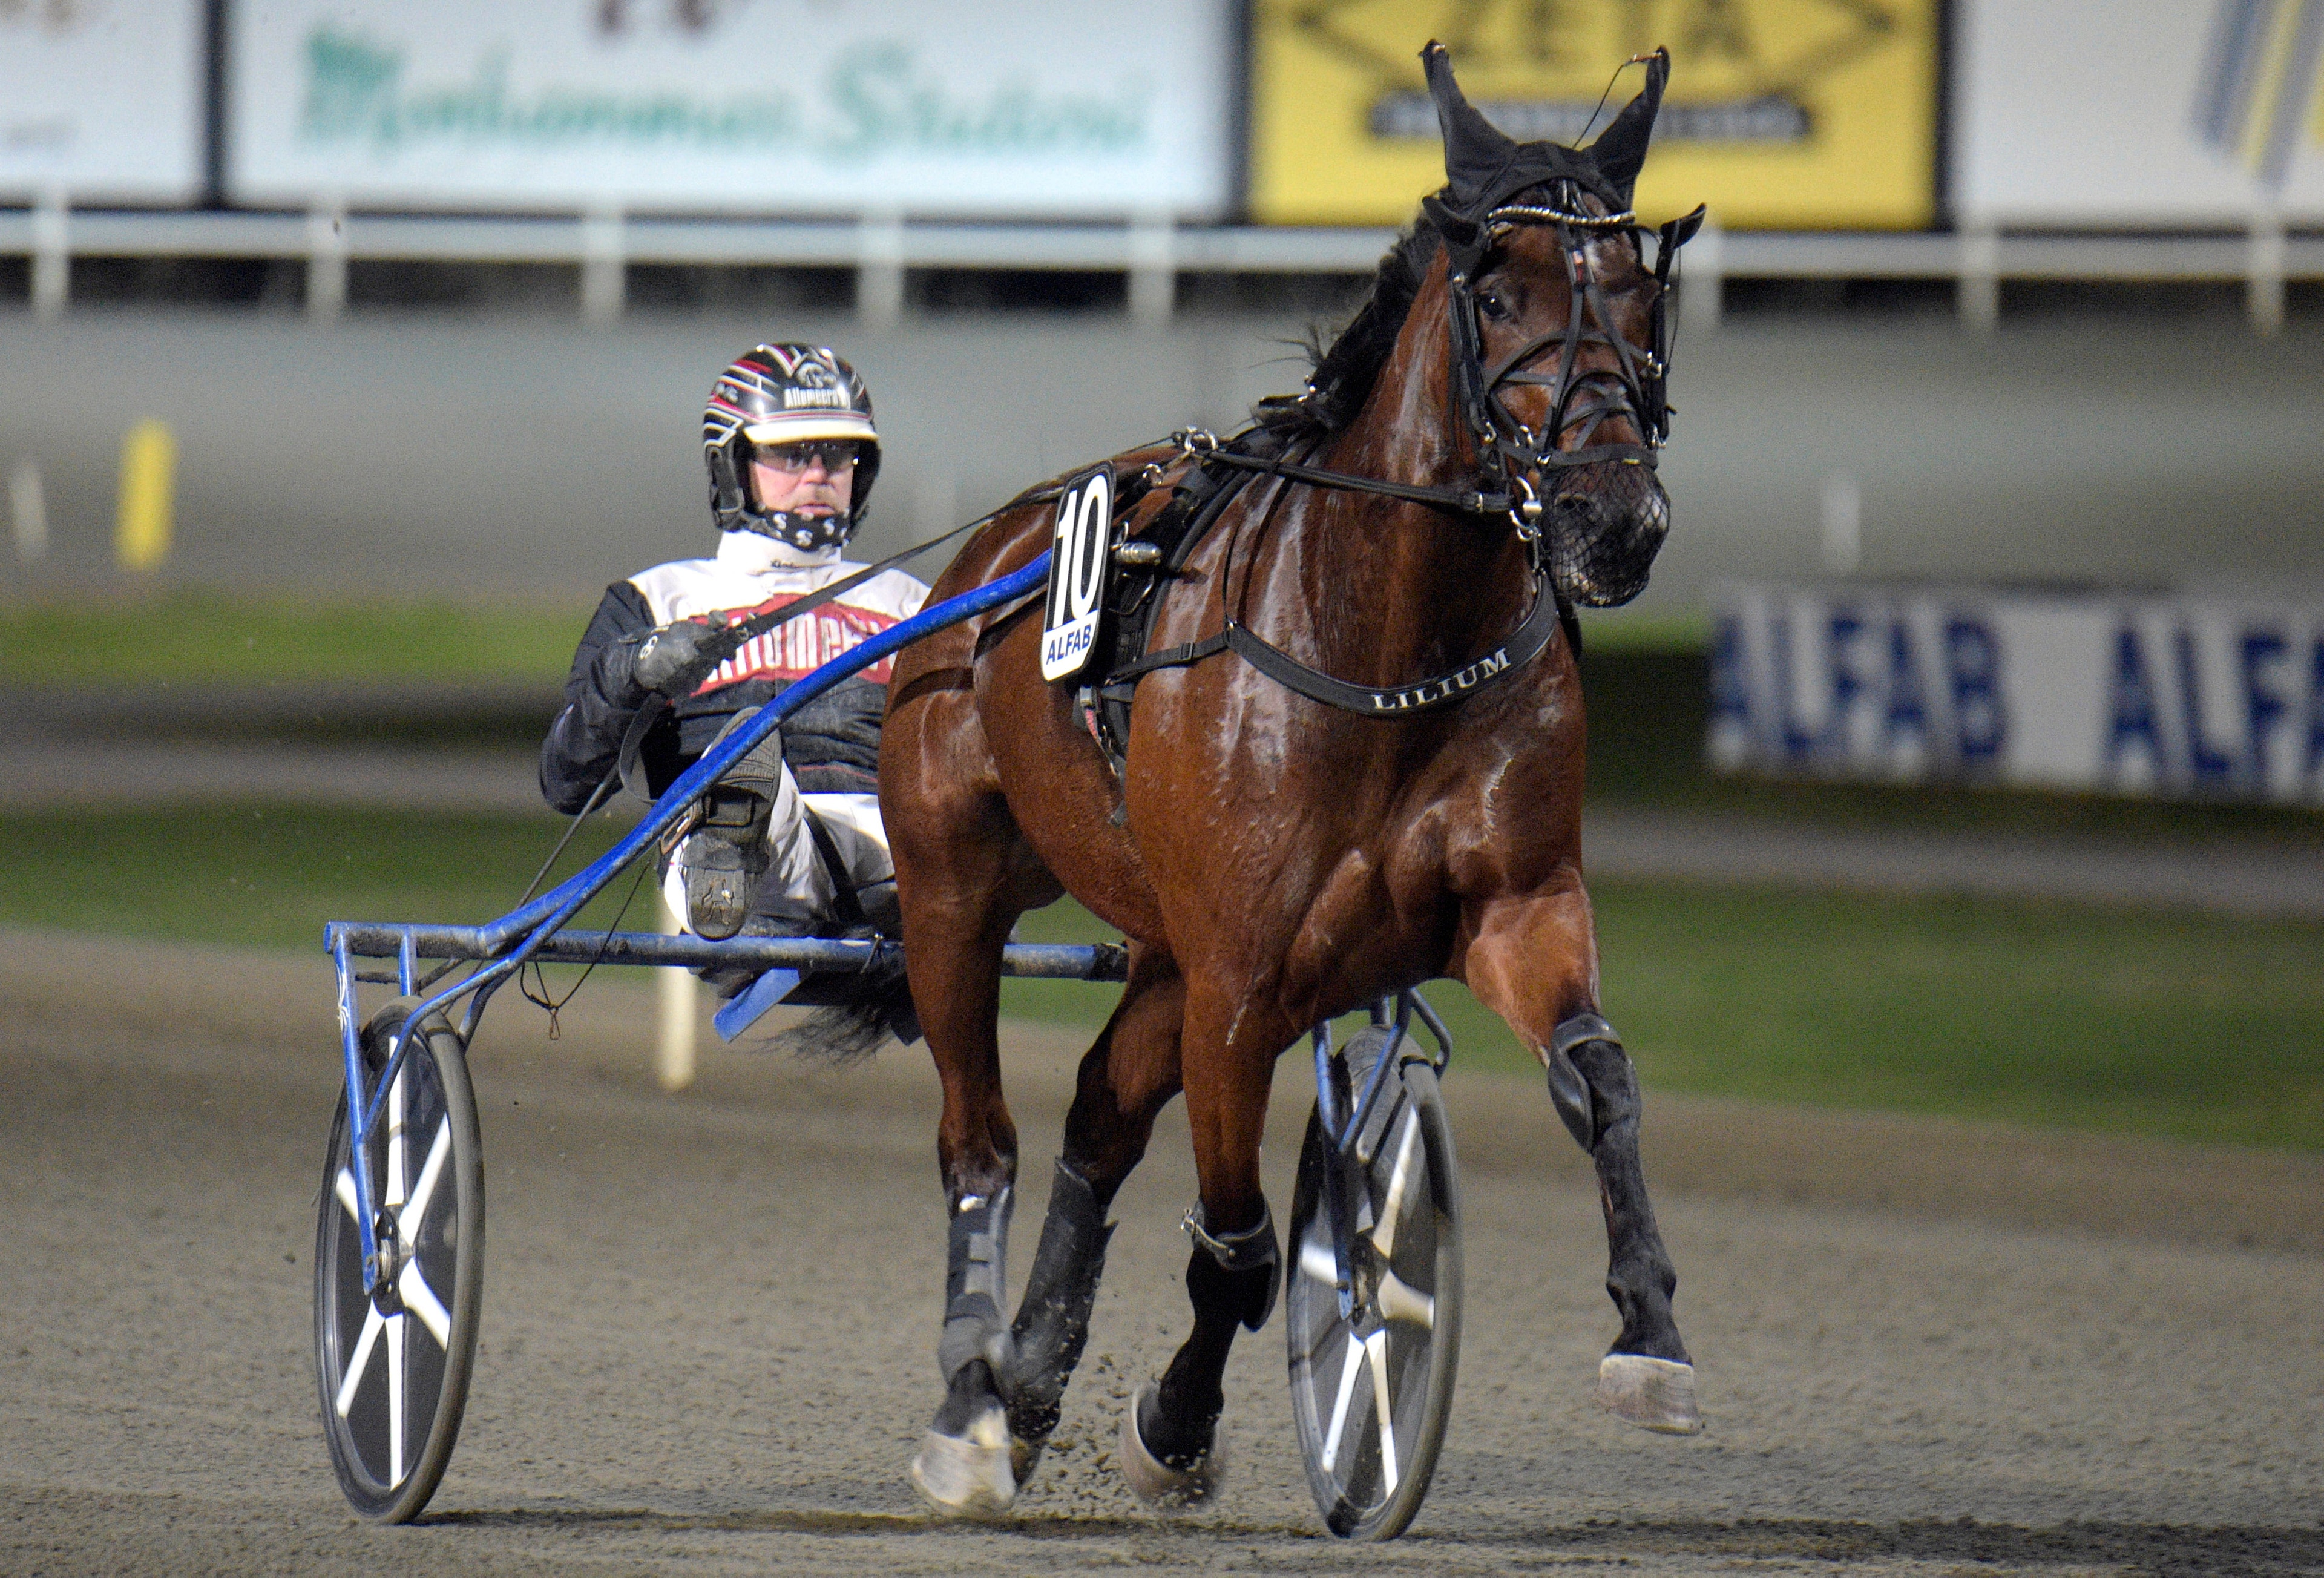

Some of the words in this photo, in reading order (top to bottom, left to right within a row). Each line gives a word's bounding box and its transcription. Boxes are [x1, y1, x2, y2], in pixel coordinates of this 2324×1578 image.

[1053, 475, 1108, 628] 10
[1046, 624, 1092, 665] ALFAB
[1371, 648, 1511, 710] LILIUM
[1710, 611, 2004, 766] ALFAB
[2098, 622, 2324, 789] ALF
